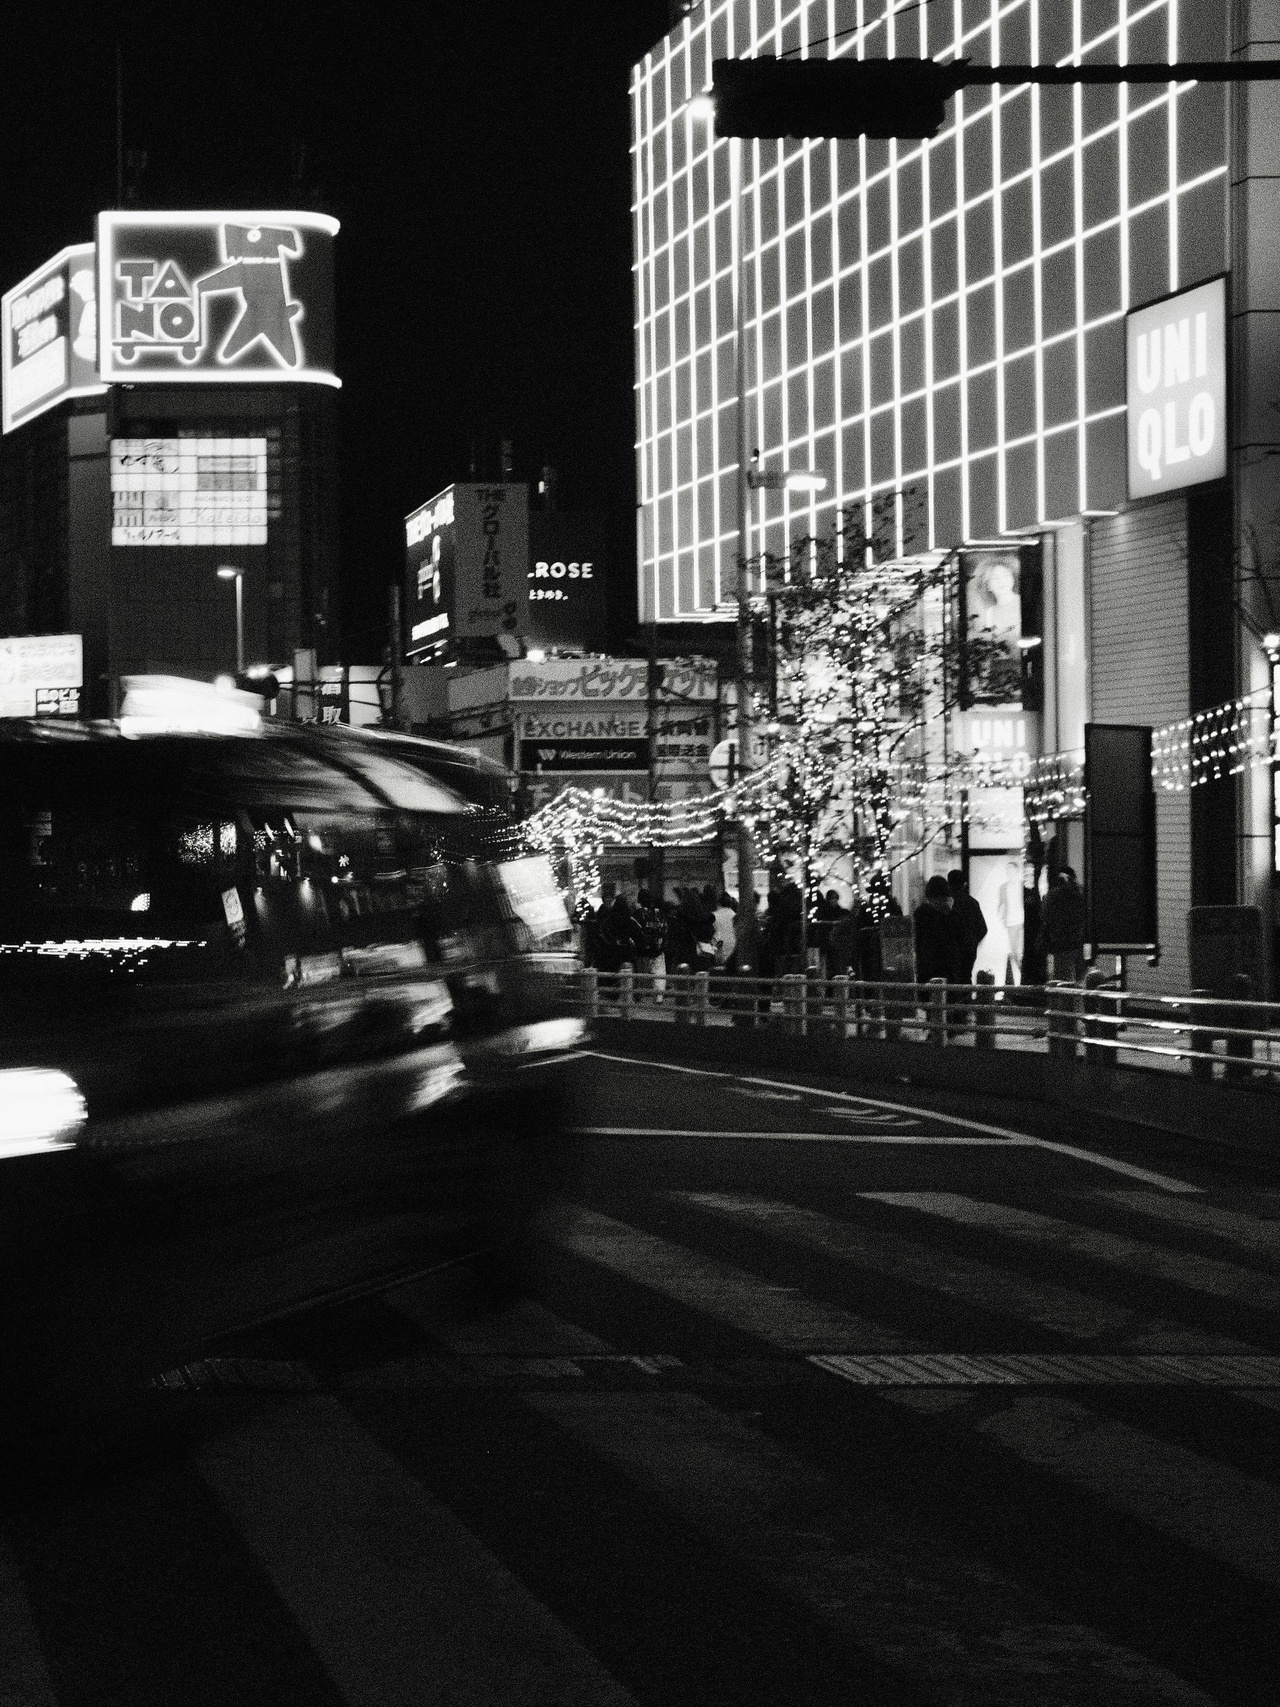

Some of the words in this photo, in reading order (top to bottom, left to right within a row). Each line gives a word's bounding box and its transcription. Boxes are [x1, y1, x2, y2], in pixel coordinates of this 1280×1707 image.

[1137, 311, 1207, 394] UNI
[1137, 392, 1215, 481] QLO
[524, 720, 640, 738] EXCHANGE
